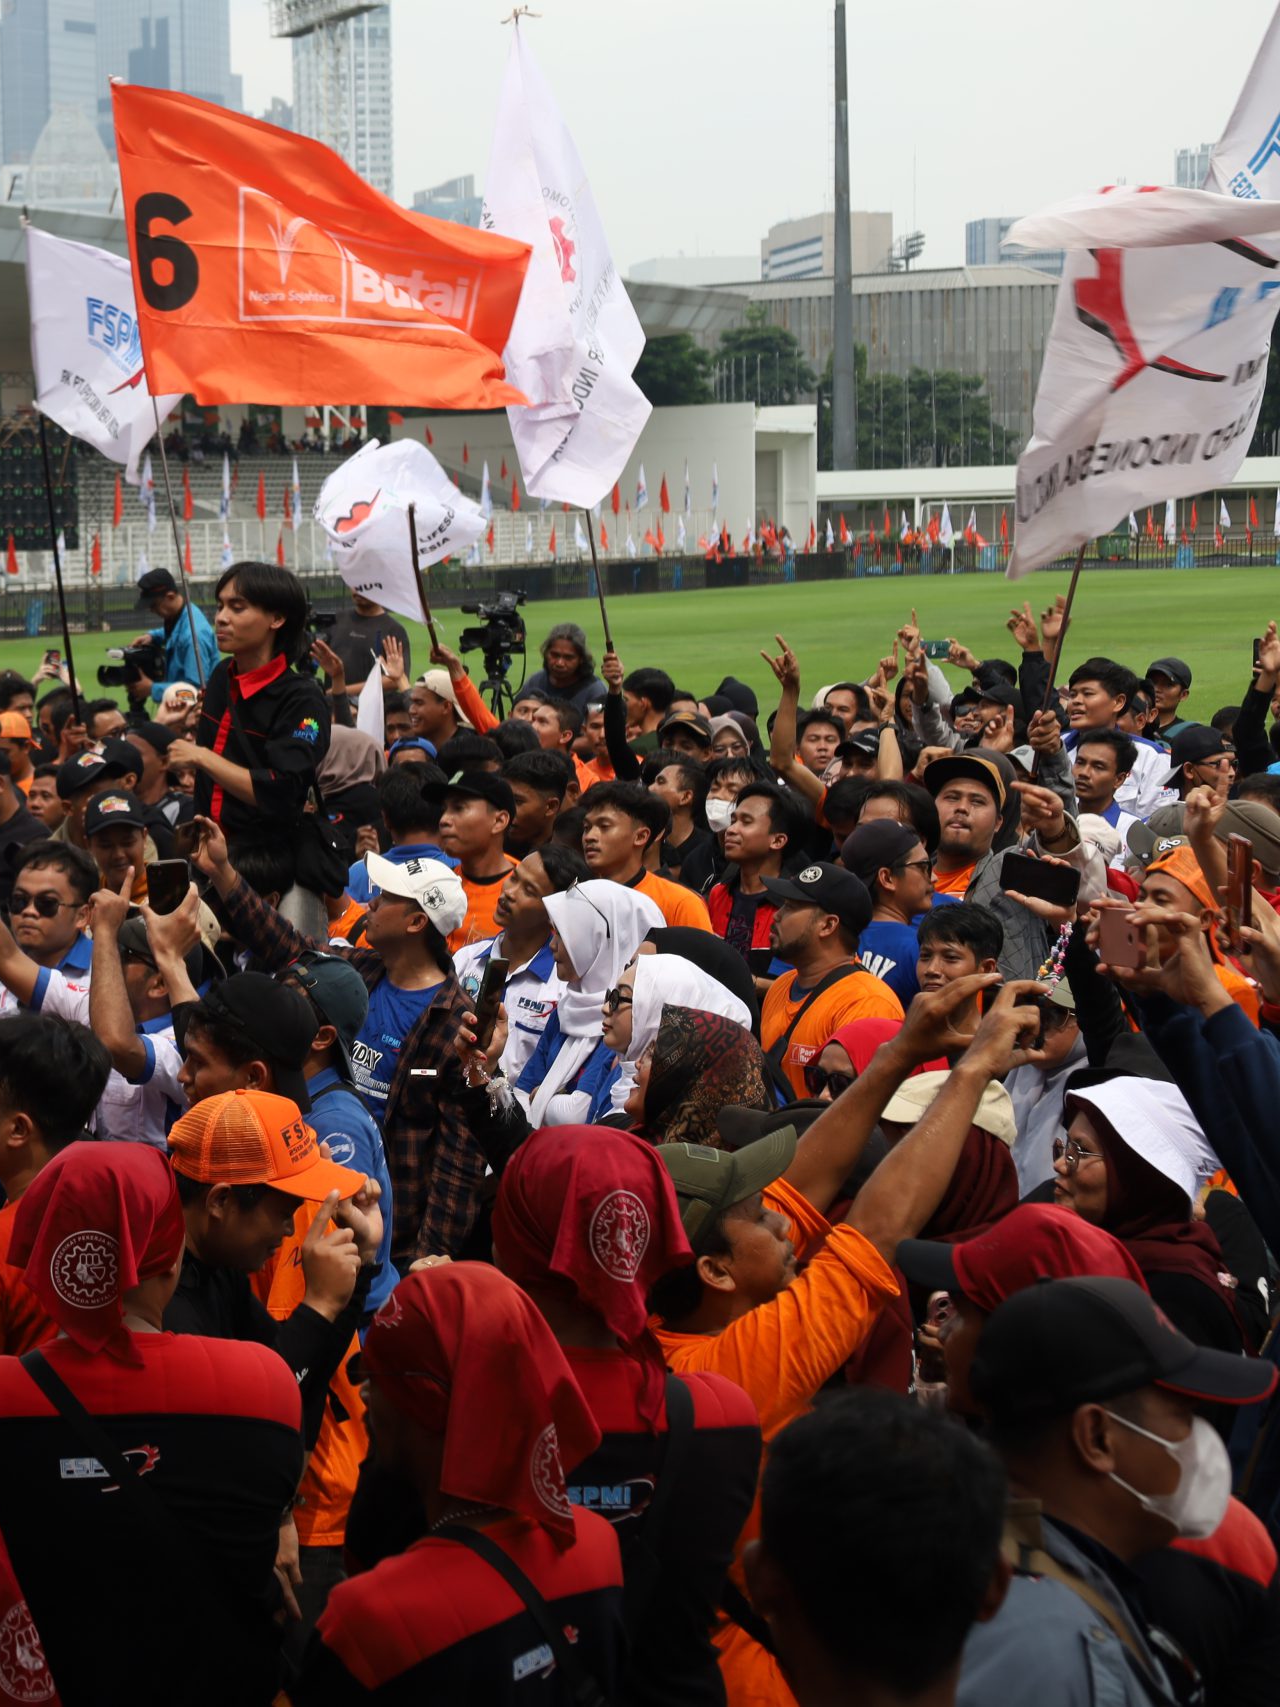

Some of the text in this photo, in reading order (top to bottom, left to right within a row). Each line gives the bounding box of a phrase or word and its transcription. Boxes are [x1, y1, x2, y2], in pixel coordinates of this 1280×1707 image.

[134, 191, 200, 313] 6
[248, 289, 336, 305] Negara Sejahtera
[85, 296, 144, 369] FSPM
[566, 1486, 632, 1505] SPMI
